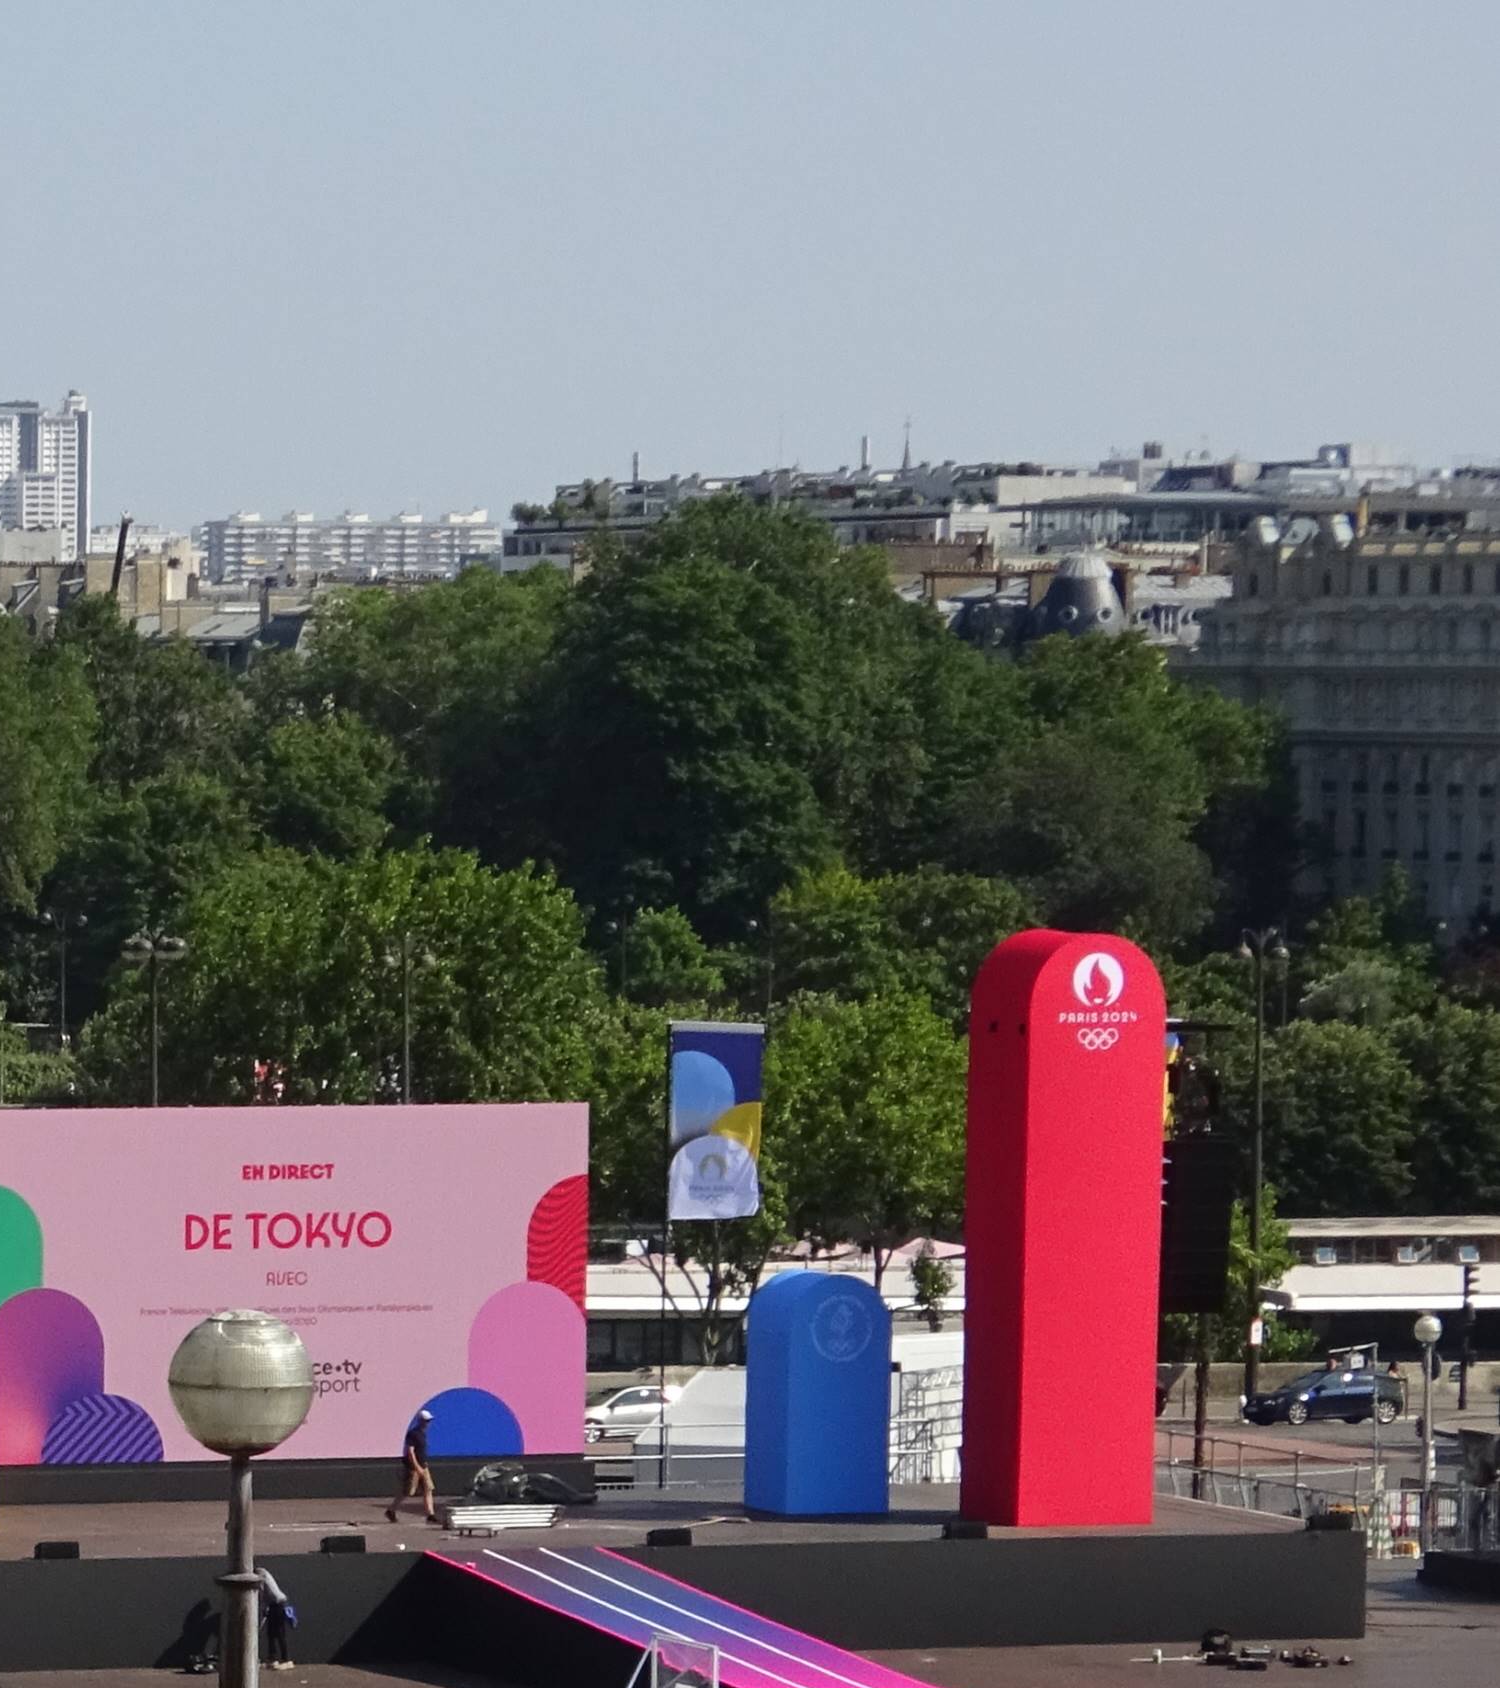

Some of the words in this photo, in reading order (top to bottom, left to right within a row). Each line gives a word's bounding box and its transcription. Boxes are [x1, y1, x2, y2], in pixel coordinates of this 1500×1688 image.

[1059, 1011, 1098, 1023] PARIS
[1101, 1011, 1138, 1023] 2024
[242, 1164, 265, 1181] EN
[268, 1163, 335, 1180] DIRECT
[184, 1214, 233, 1251] DE
[245, 1211, 393, 1250] TOKYO
[266, 1271, 308, 1287] AVEC
